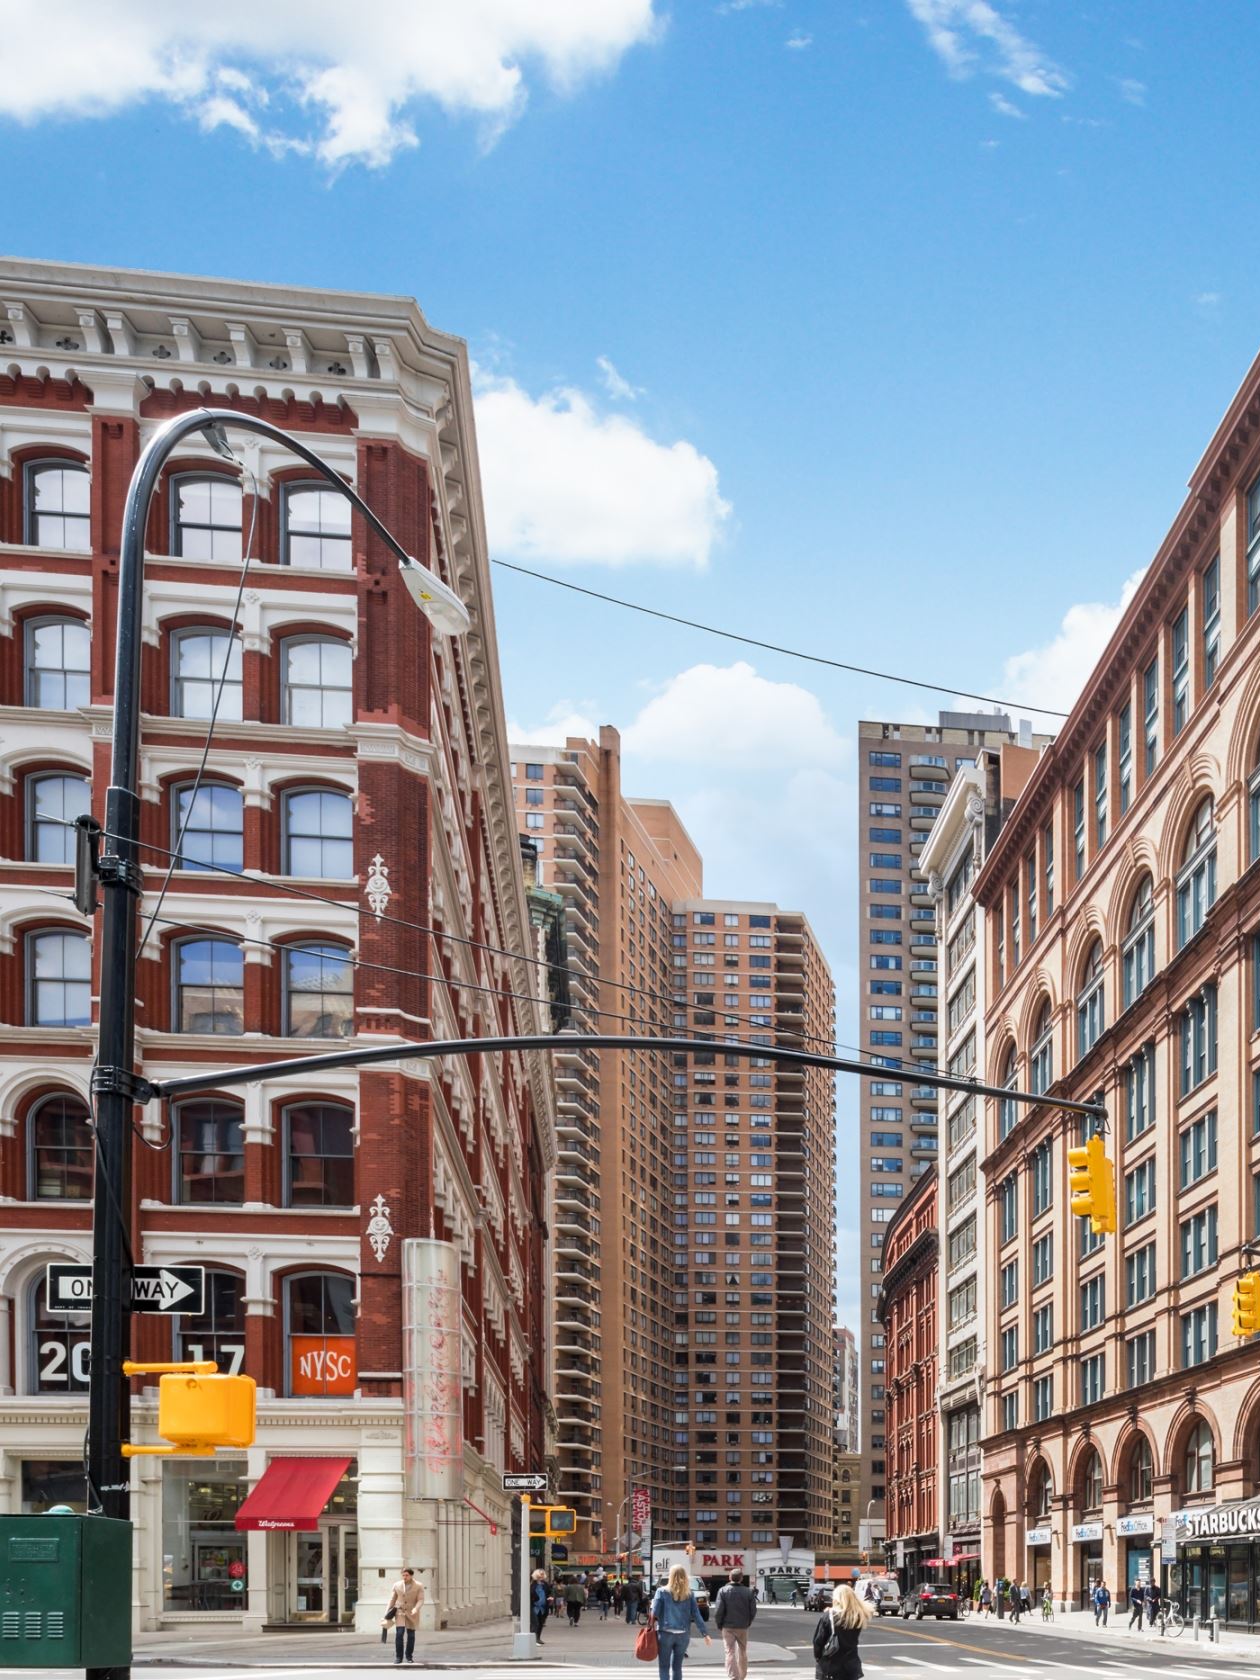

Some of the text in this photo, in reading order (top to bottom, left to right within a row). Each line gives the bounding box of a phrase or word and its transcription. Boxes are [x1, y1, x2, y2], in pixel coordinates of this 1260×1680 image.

[71, 1279, 179, 1298] ON WAY
[300, 1350, 351, 1381] NYSC
[258, 1520, 295, 1528] Walgreens
[702, 1554, 744, 1566] PARK
[769, 1567, 801, 1575] PARK
